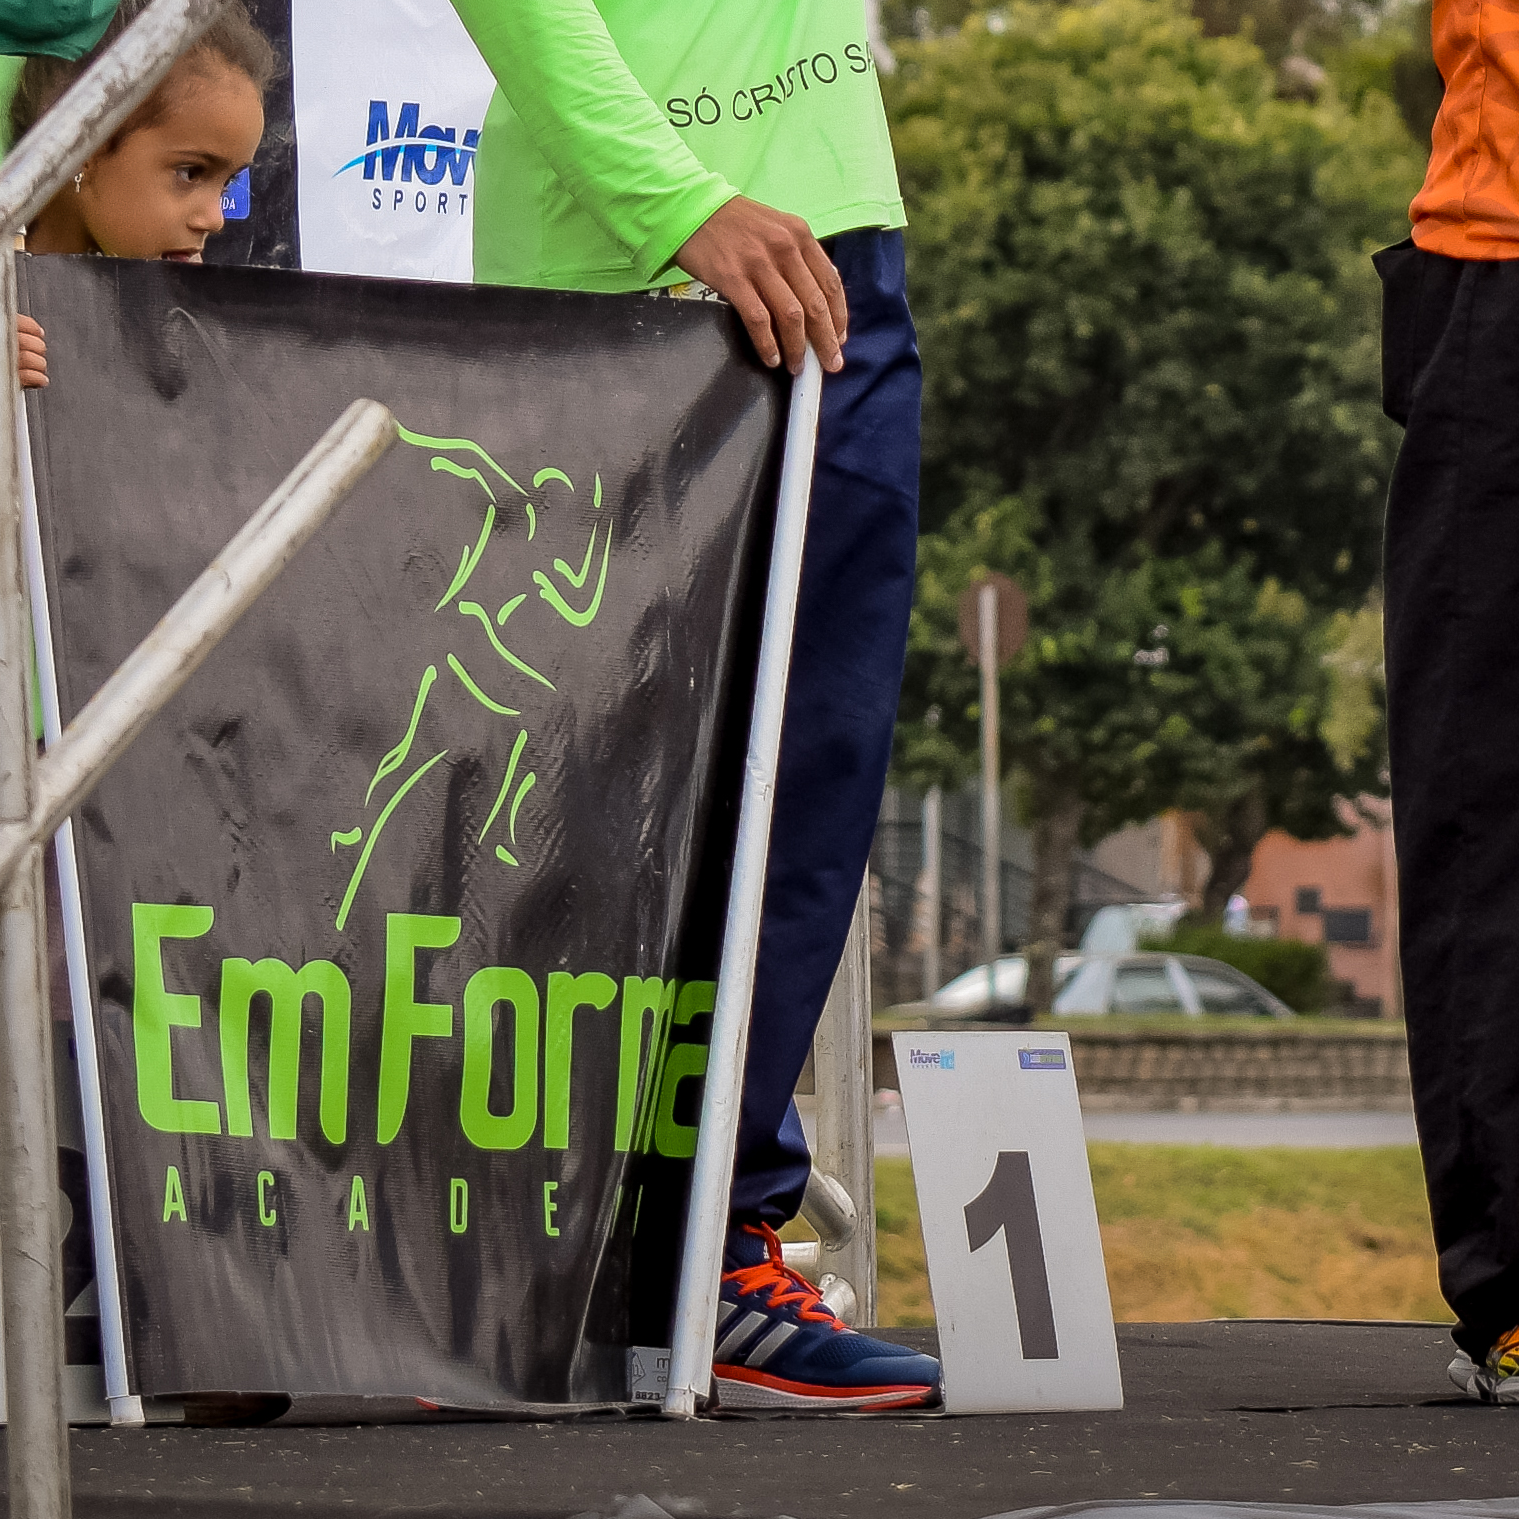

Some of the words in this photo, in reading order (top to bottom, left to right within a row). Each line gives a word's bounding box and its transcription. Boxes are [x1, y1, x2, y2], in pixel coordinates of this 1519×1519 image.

[666, 86, 721, 128] SÓ
[732, 52, 838, 121] CRISTO
[371, 188, 469, 216] SPORT
[163, 1165, 560, 1238] ACADE
[963, 1150, 1060, 1360] 1
